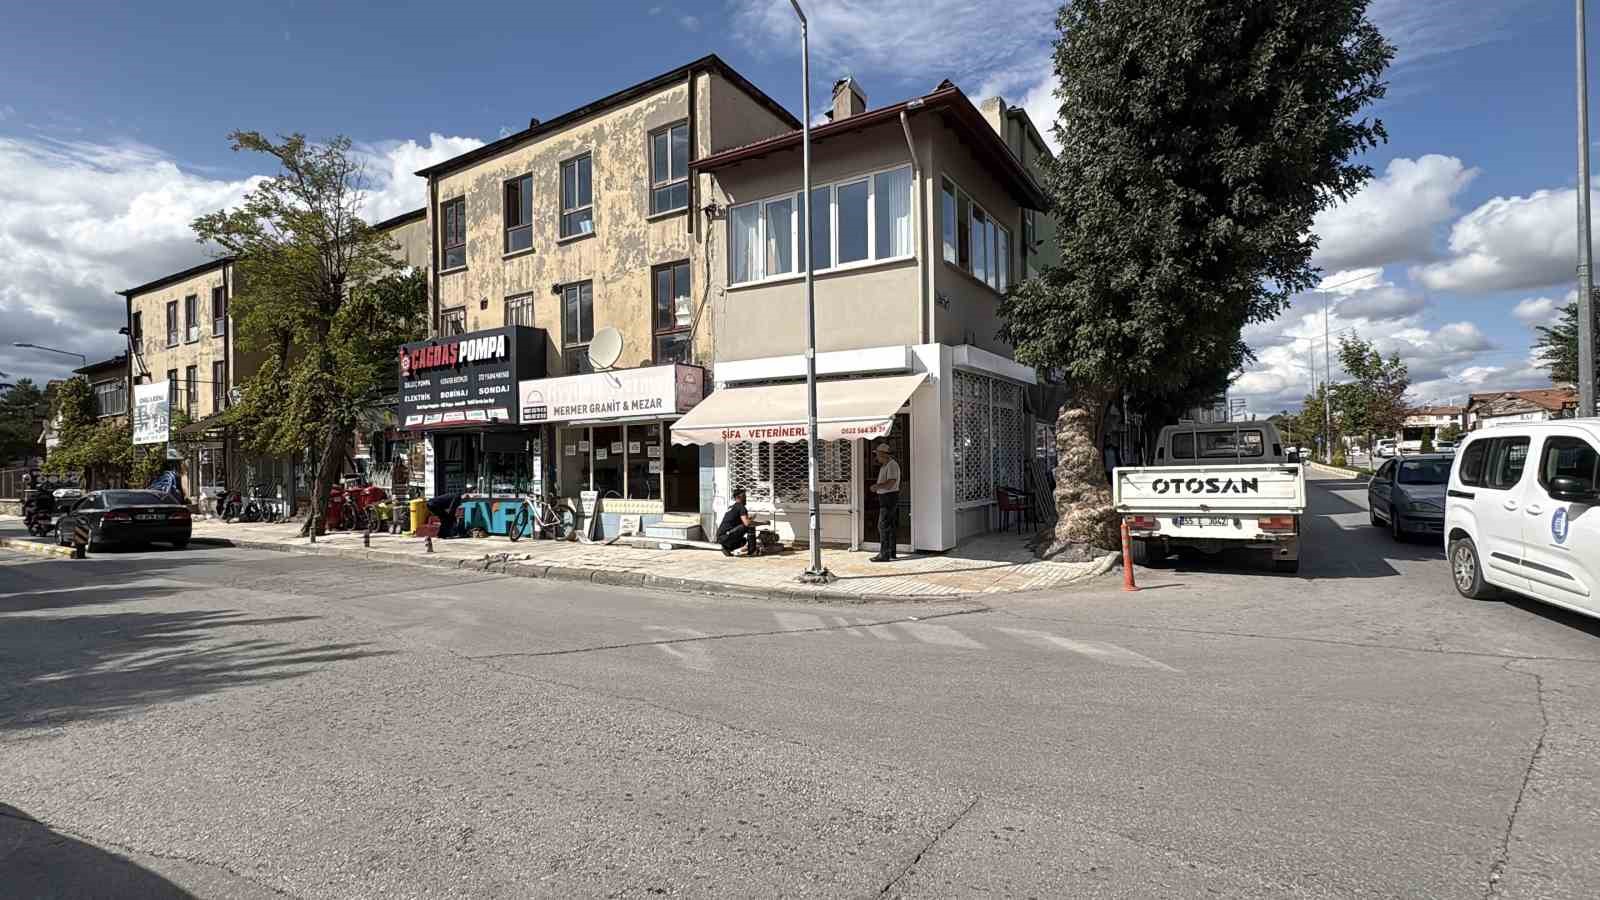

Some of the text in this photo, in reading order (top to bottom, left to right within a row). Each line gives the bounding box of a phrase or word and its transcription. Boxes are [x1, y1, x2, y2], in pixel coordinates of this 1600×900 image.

[458, 334, 505, 362] POMPA
[478, 385, 510, 395] SONDAJ
[554, 402, 588, 416] MERMER
[589, 399, 621, 414] GRANİT
[623, 401, 630, 411] &
[631, 398, 663, 410] MEZAR
[748, 425, 808, 438] VETERİNERL
[1151, 477, 1258, 494] OTOSAN
